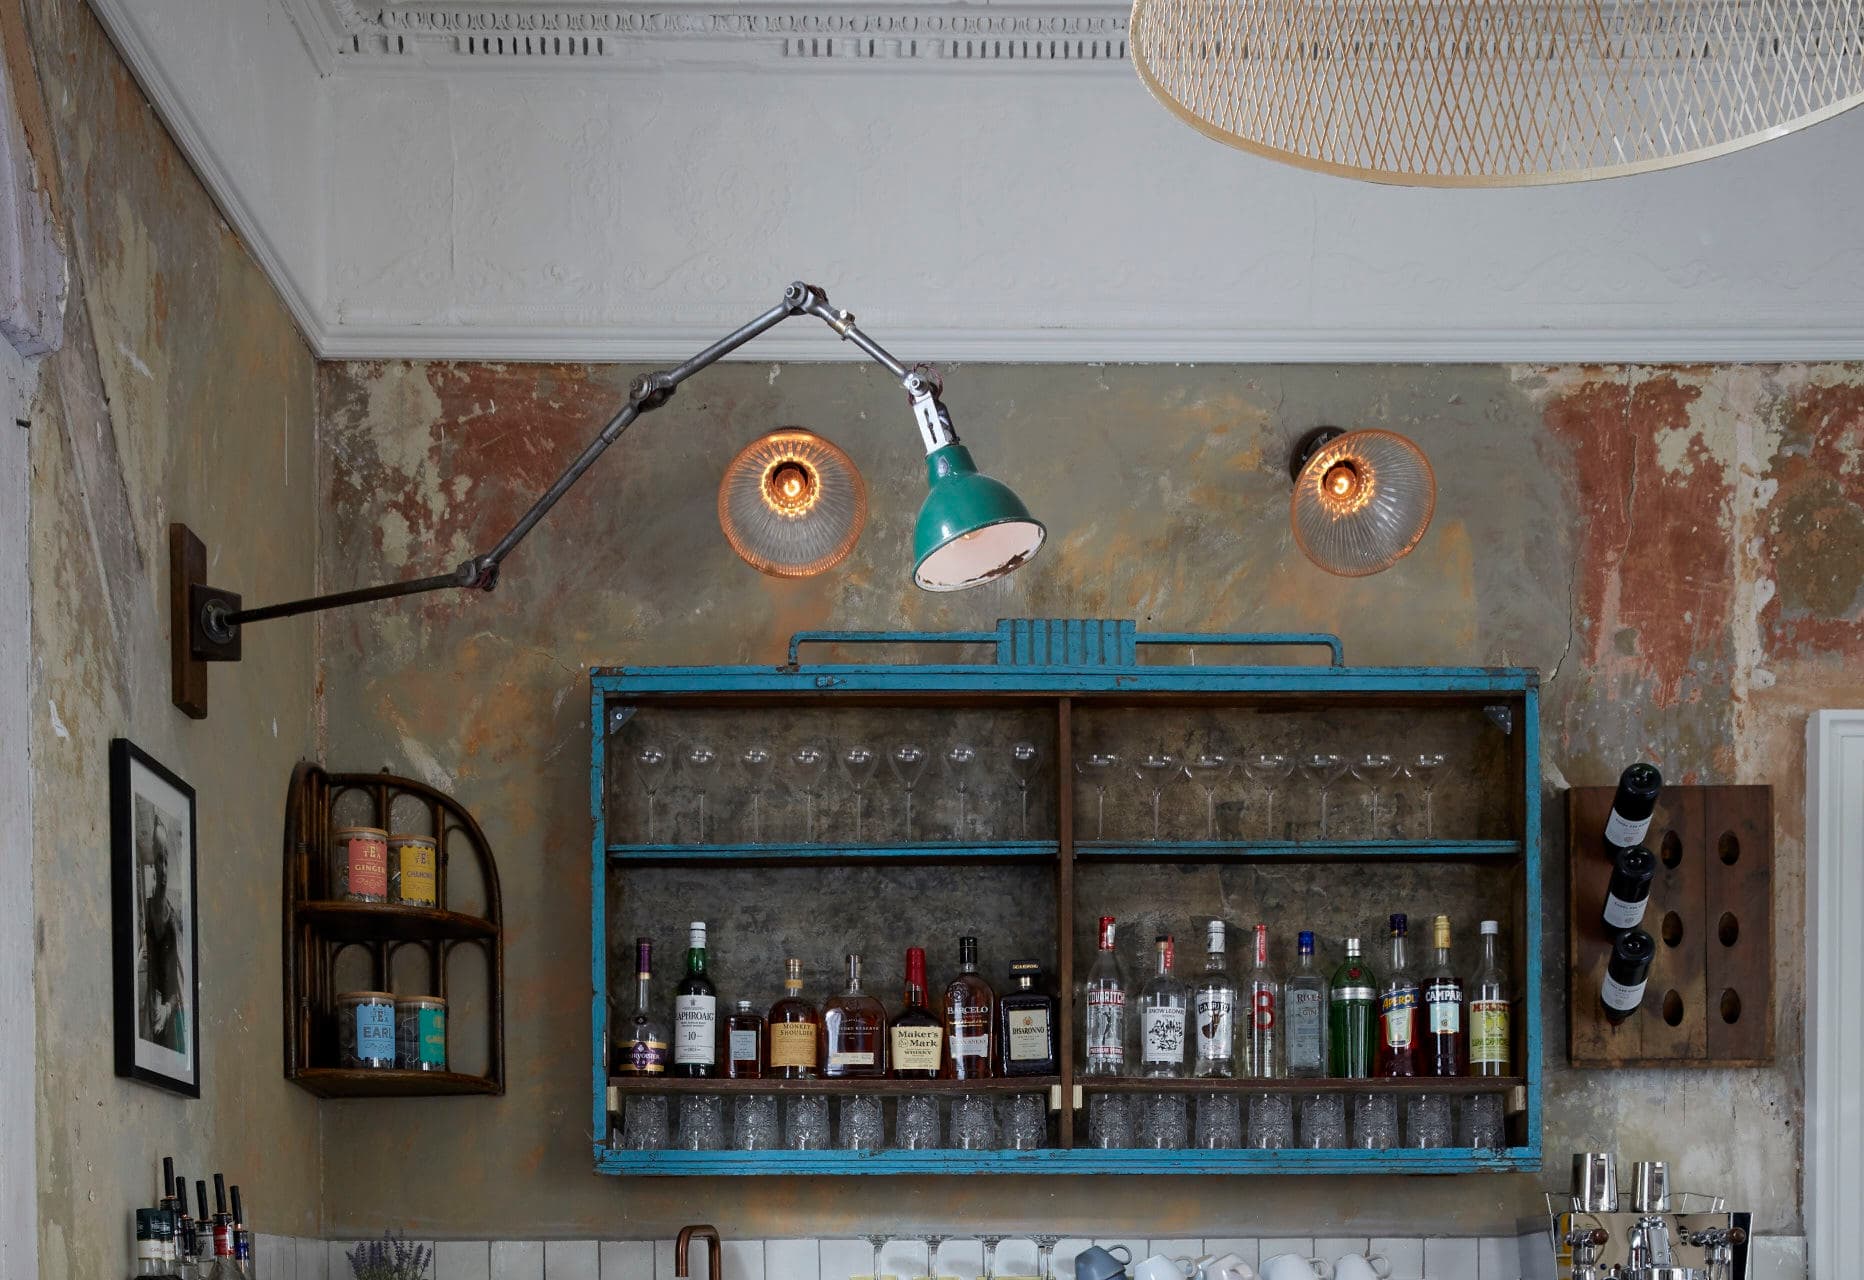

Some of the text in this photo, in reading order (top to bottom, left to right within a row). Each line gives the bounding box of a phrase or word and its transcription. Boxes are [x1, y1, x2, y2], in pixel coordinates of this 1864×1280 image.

[1425, 990, 1463, 1002] CAMPARI
[1383, 994, 1416, 1009] APEROL
[897, 1030, 939, 1038] Maker's
[1012, 1026, 1045, 1035] DISARONNO
[688, 1031, 697, 1041] 10
[909, 1039, 938, 1047] Mark
